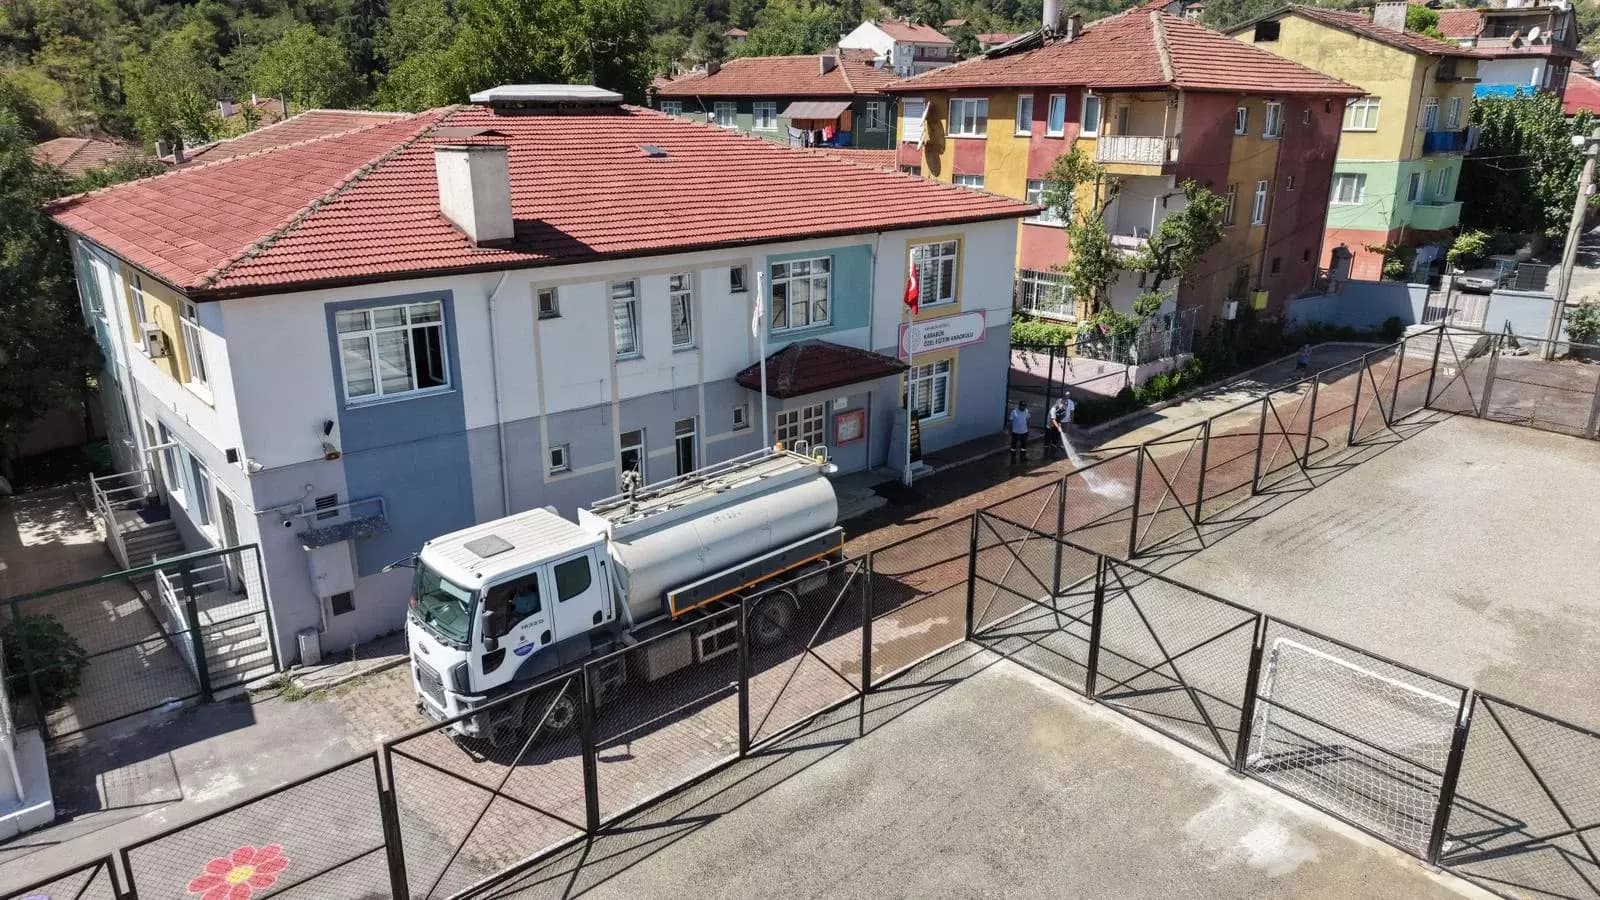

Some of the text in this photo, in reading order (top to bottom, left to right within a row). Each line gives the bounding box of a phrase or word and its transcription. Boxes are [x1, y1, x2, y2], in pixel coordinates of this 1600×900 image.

[923, 330, 944, 339] KARABÜK
[923, 339, 935, 347] ÖZEL
[951, 332, 974, 341] ANAOKULU
